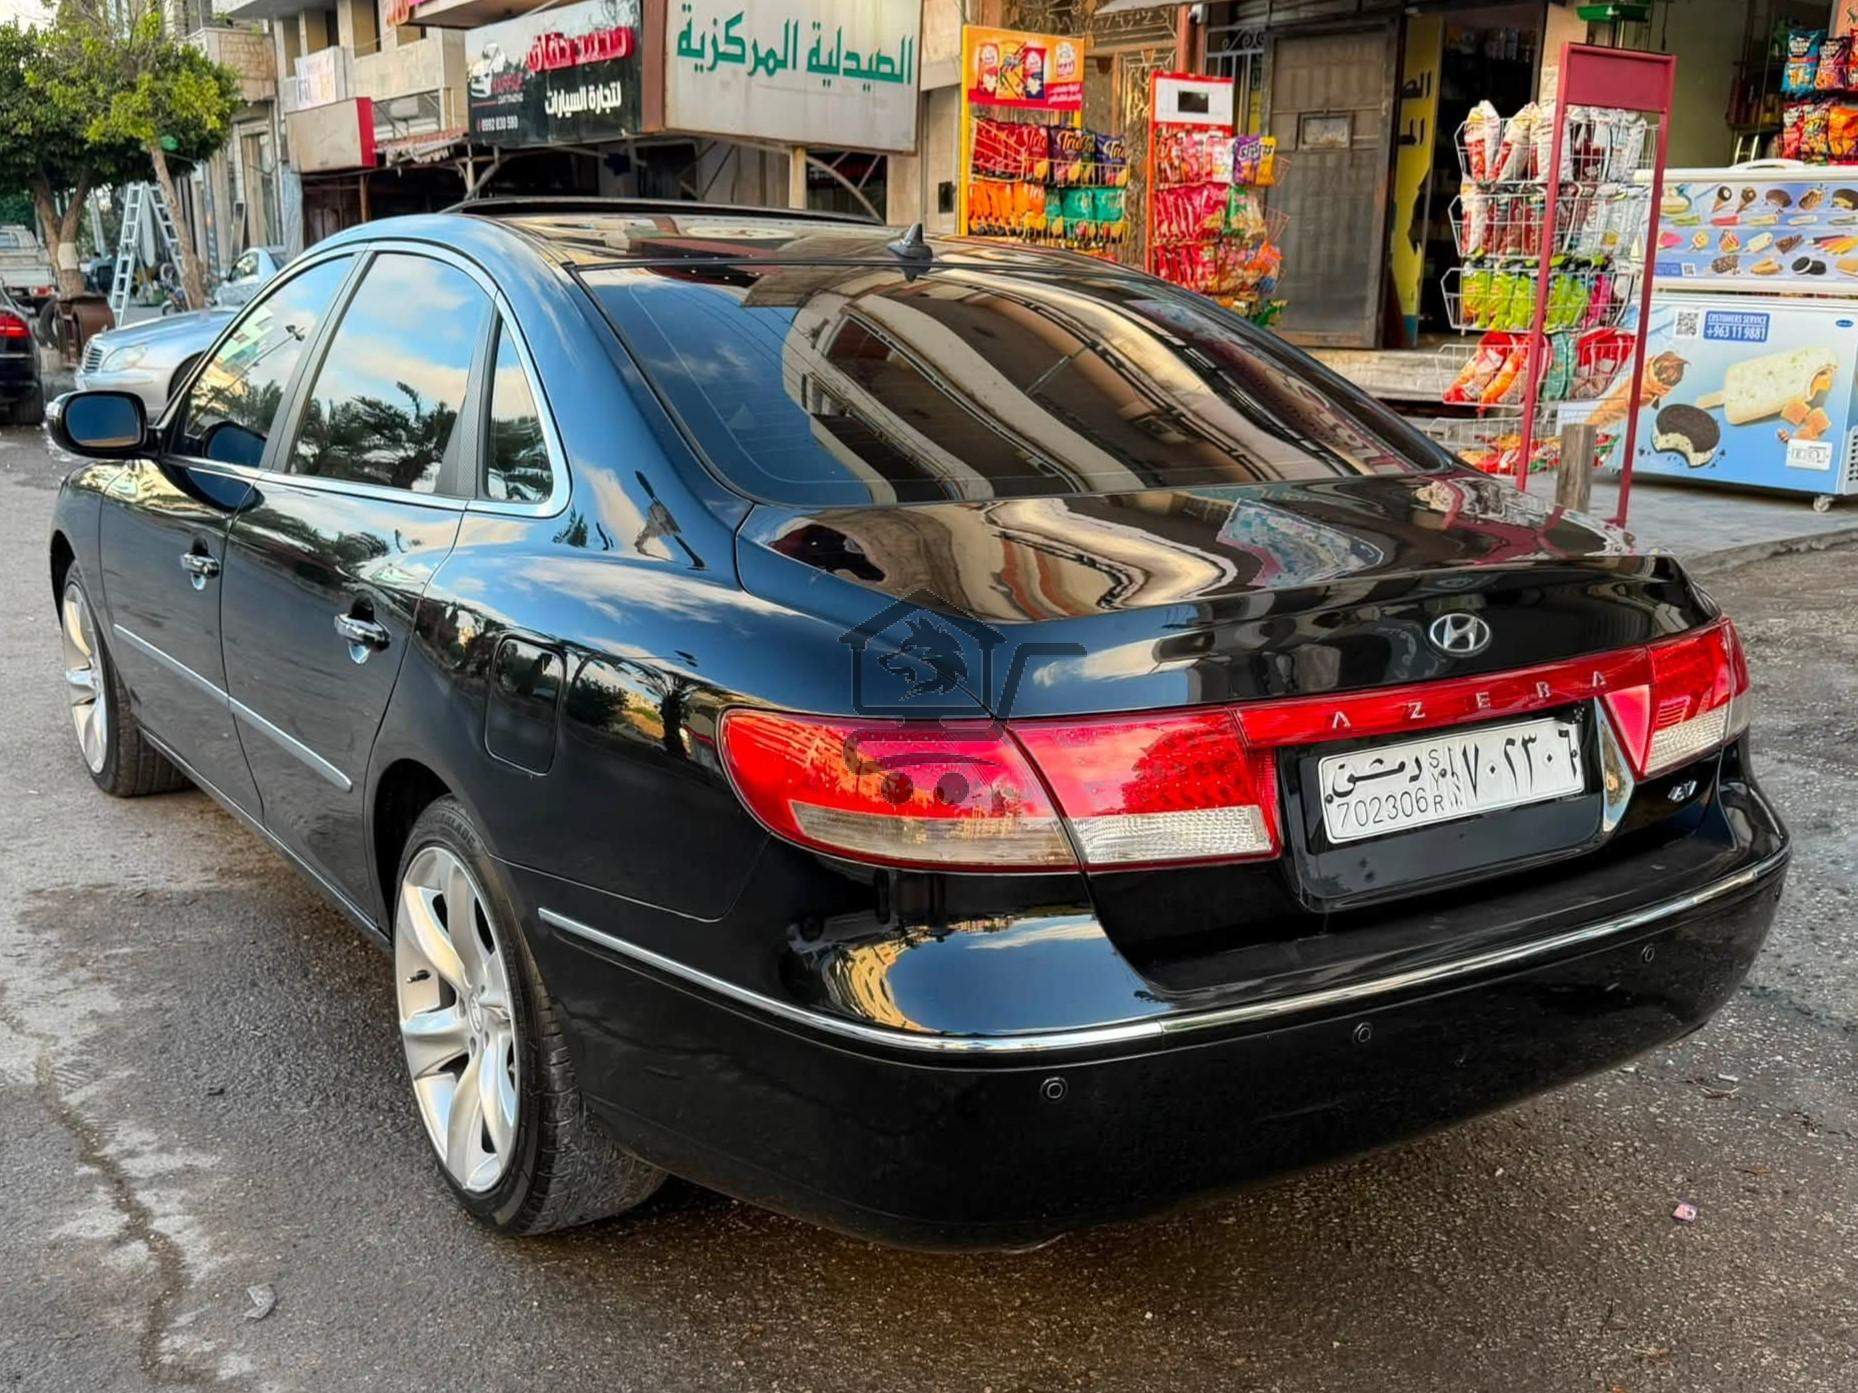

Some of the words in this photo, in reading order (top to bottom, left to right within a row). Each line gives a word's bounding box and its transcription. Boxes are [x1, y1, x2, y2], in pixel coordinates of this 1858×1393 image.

[677, 3, 799, 76] المركزية
[807, 21, 914, 92] الصيدلية
[544, 85, 587, 119] السيارات
[588, 81, 621, 115] لتجارة
[1706, 325, 1729, 338] +963
[1732, 326, 1741, 338] 11
[1743, 327, 1766, 339] 9881
[1707, 313, 1742, 323] CUSTOMERS
[1743, 315, 1767, 324] SERVICE
[1332, 670, 1606, 729] AZERA
[1331, 755, 1423, 798] دمشق
[1337, 788, 1429, 828] 702306
